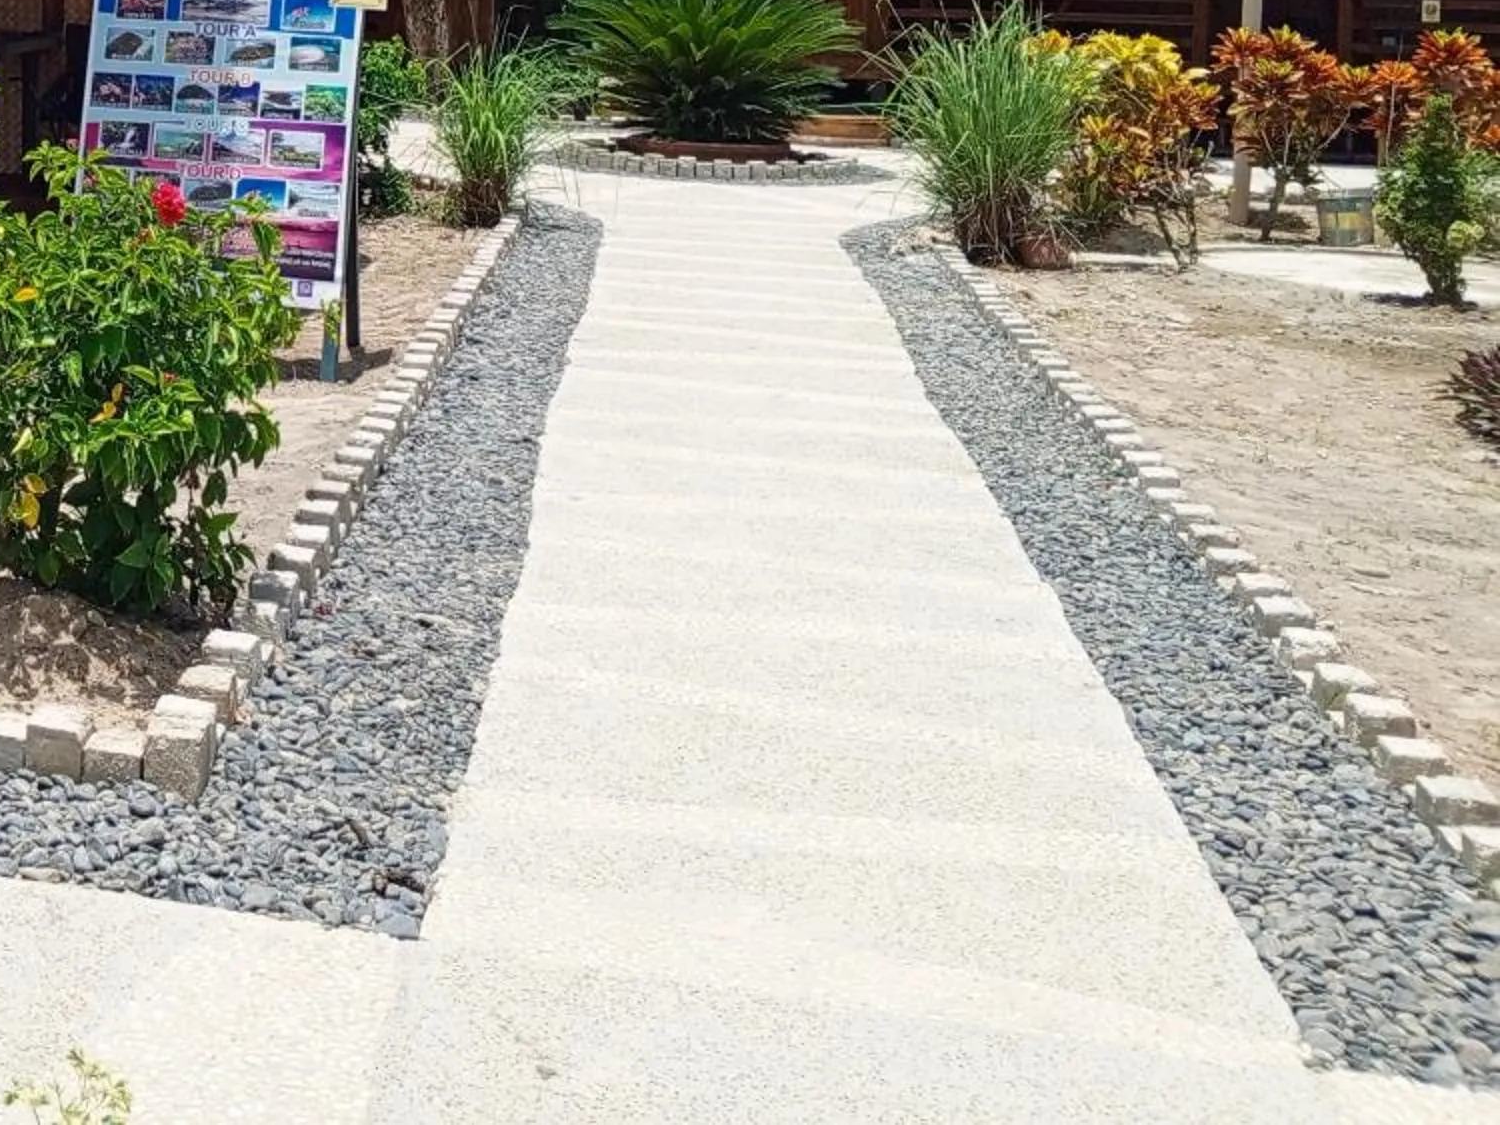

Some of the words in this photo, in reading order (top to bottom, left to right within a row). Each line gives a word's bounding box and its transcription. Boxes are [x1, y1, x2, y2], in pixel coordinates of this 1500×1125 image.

[195, 22, 241, 37] TOUR
[243, 24, 257, 38] A
[190, 69, 236, 85] TOUR
[180, 162, 226, 179] TOUR
